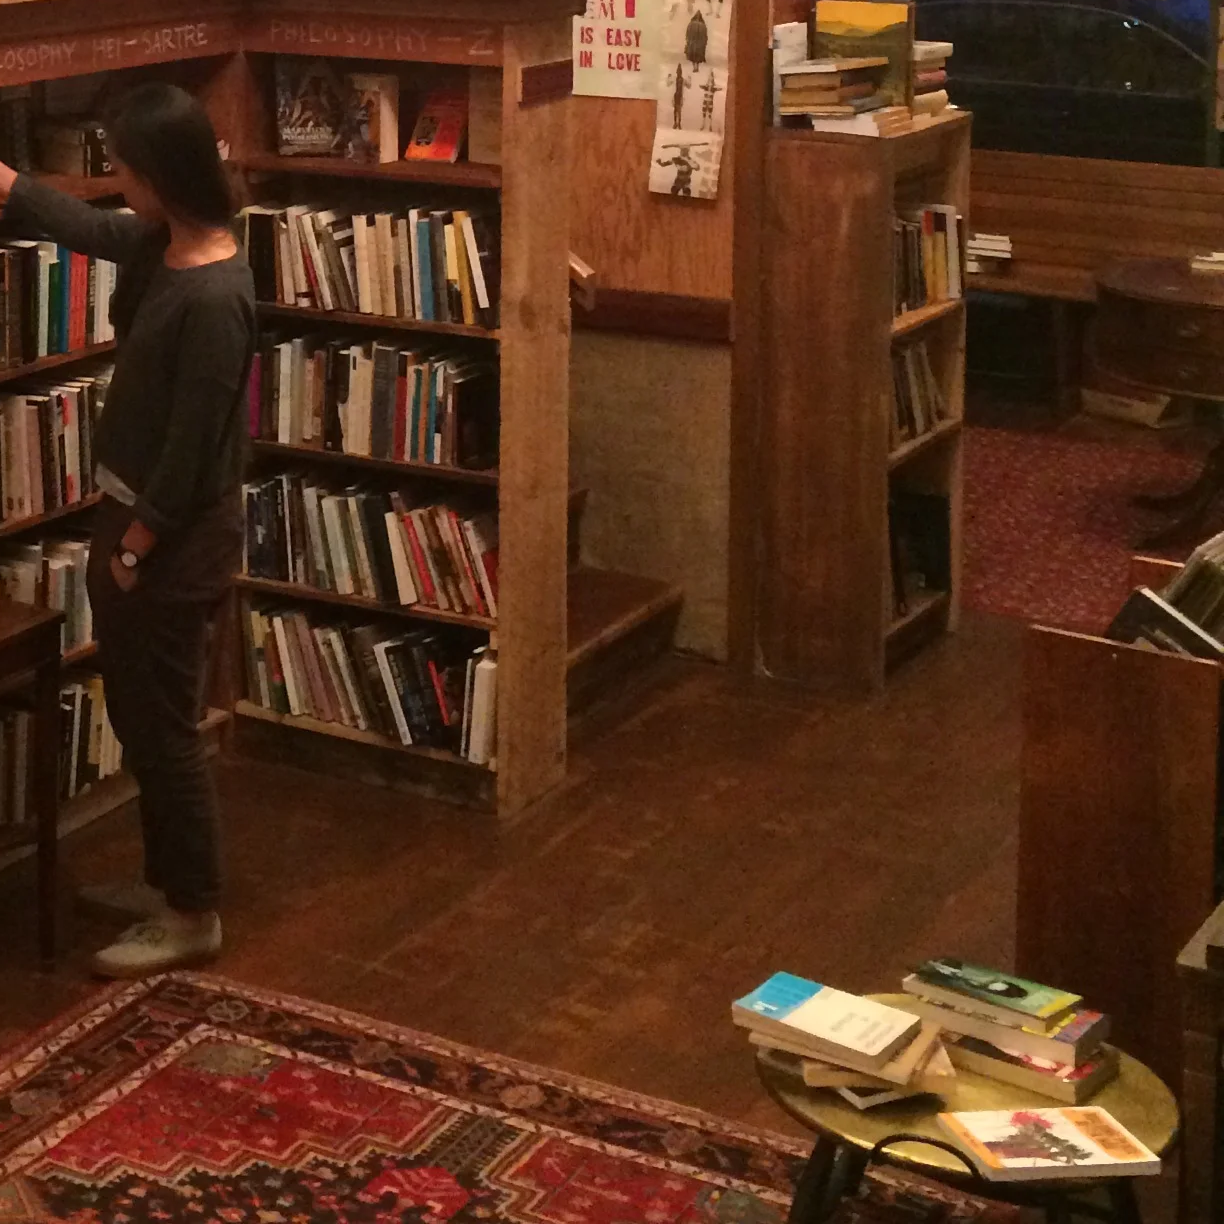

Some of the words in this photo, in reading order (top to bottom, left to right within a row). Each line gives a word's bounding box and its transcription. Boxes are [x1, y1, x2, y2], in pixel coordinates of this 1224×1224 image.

[271, 19, 429, 53] PHILOSOPHY
[580, 26, 594, 45] IS
[606, 28, 642, 48] EASY
[579, 51, 593, 68] IN
[608, 52, 641, 72] LOVE
